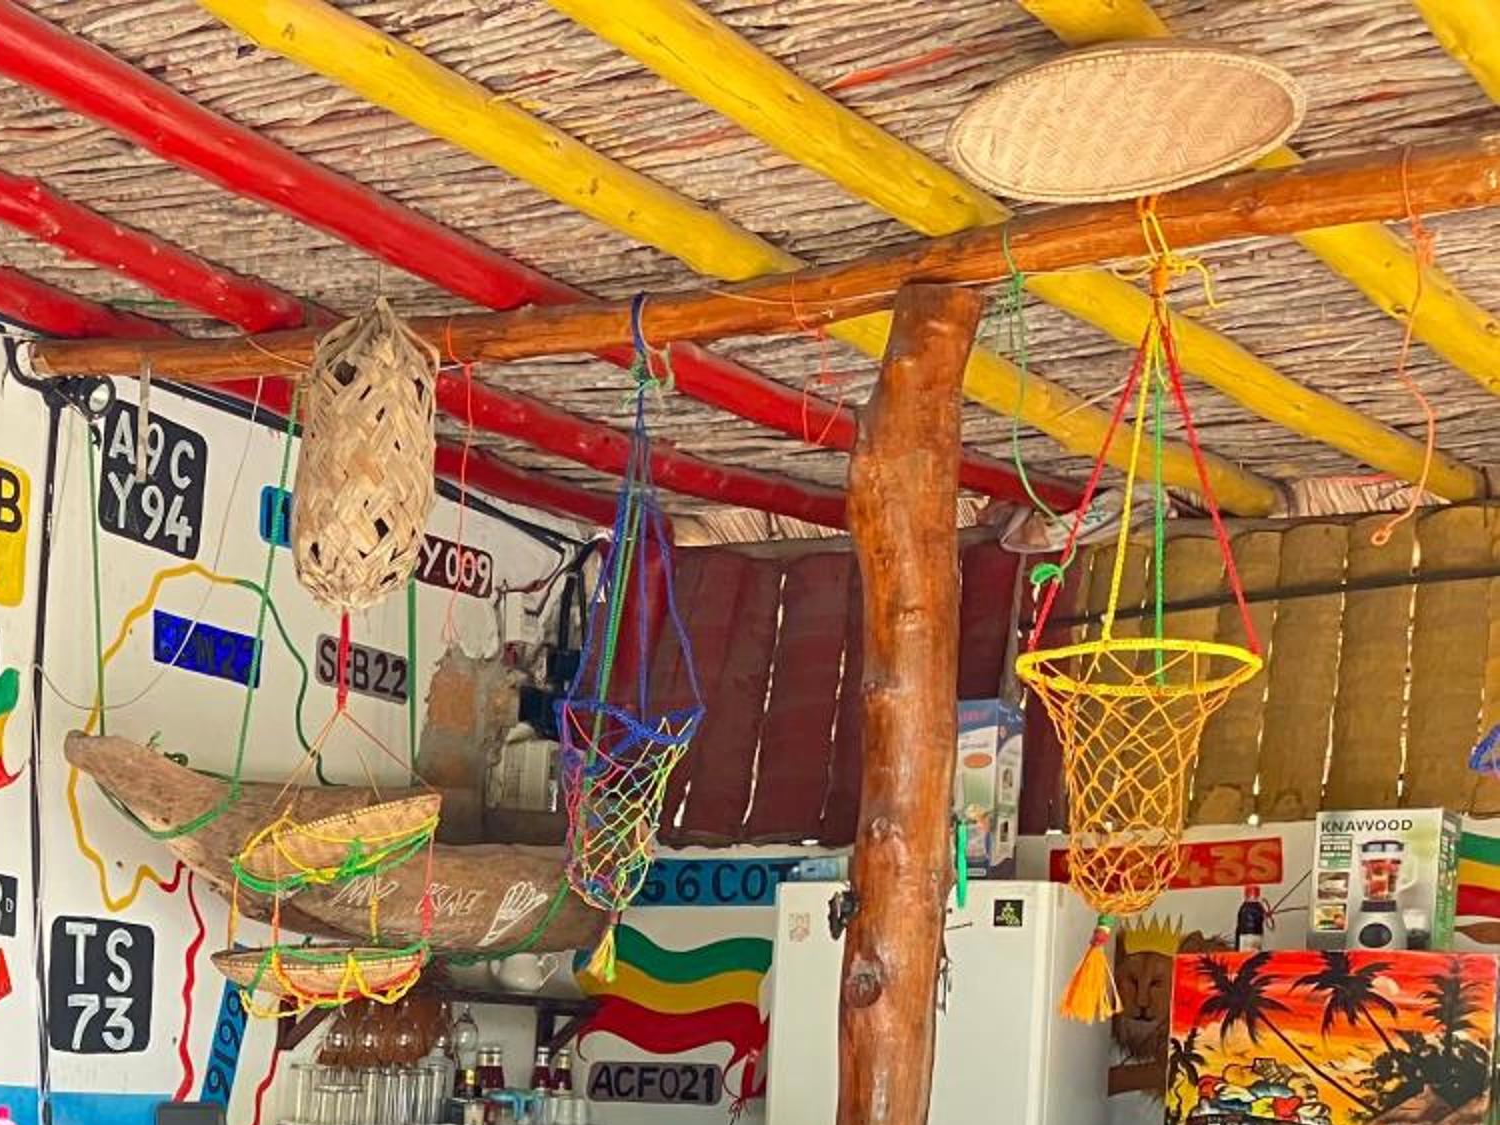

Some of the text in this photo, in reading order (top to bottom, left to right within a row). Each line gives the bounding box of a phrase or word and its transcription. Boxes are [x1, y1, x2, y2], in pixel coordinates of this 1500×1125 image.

[107, 471, 192, 552] Y94
[65, 921, 134, 993] TS
[67, 993, 135, 1051] 73
